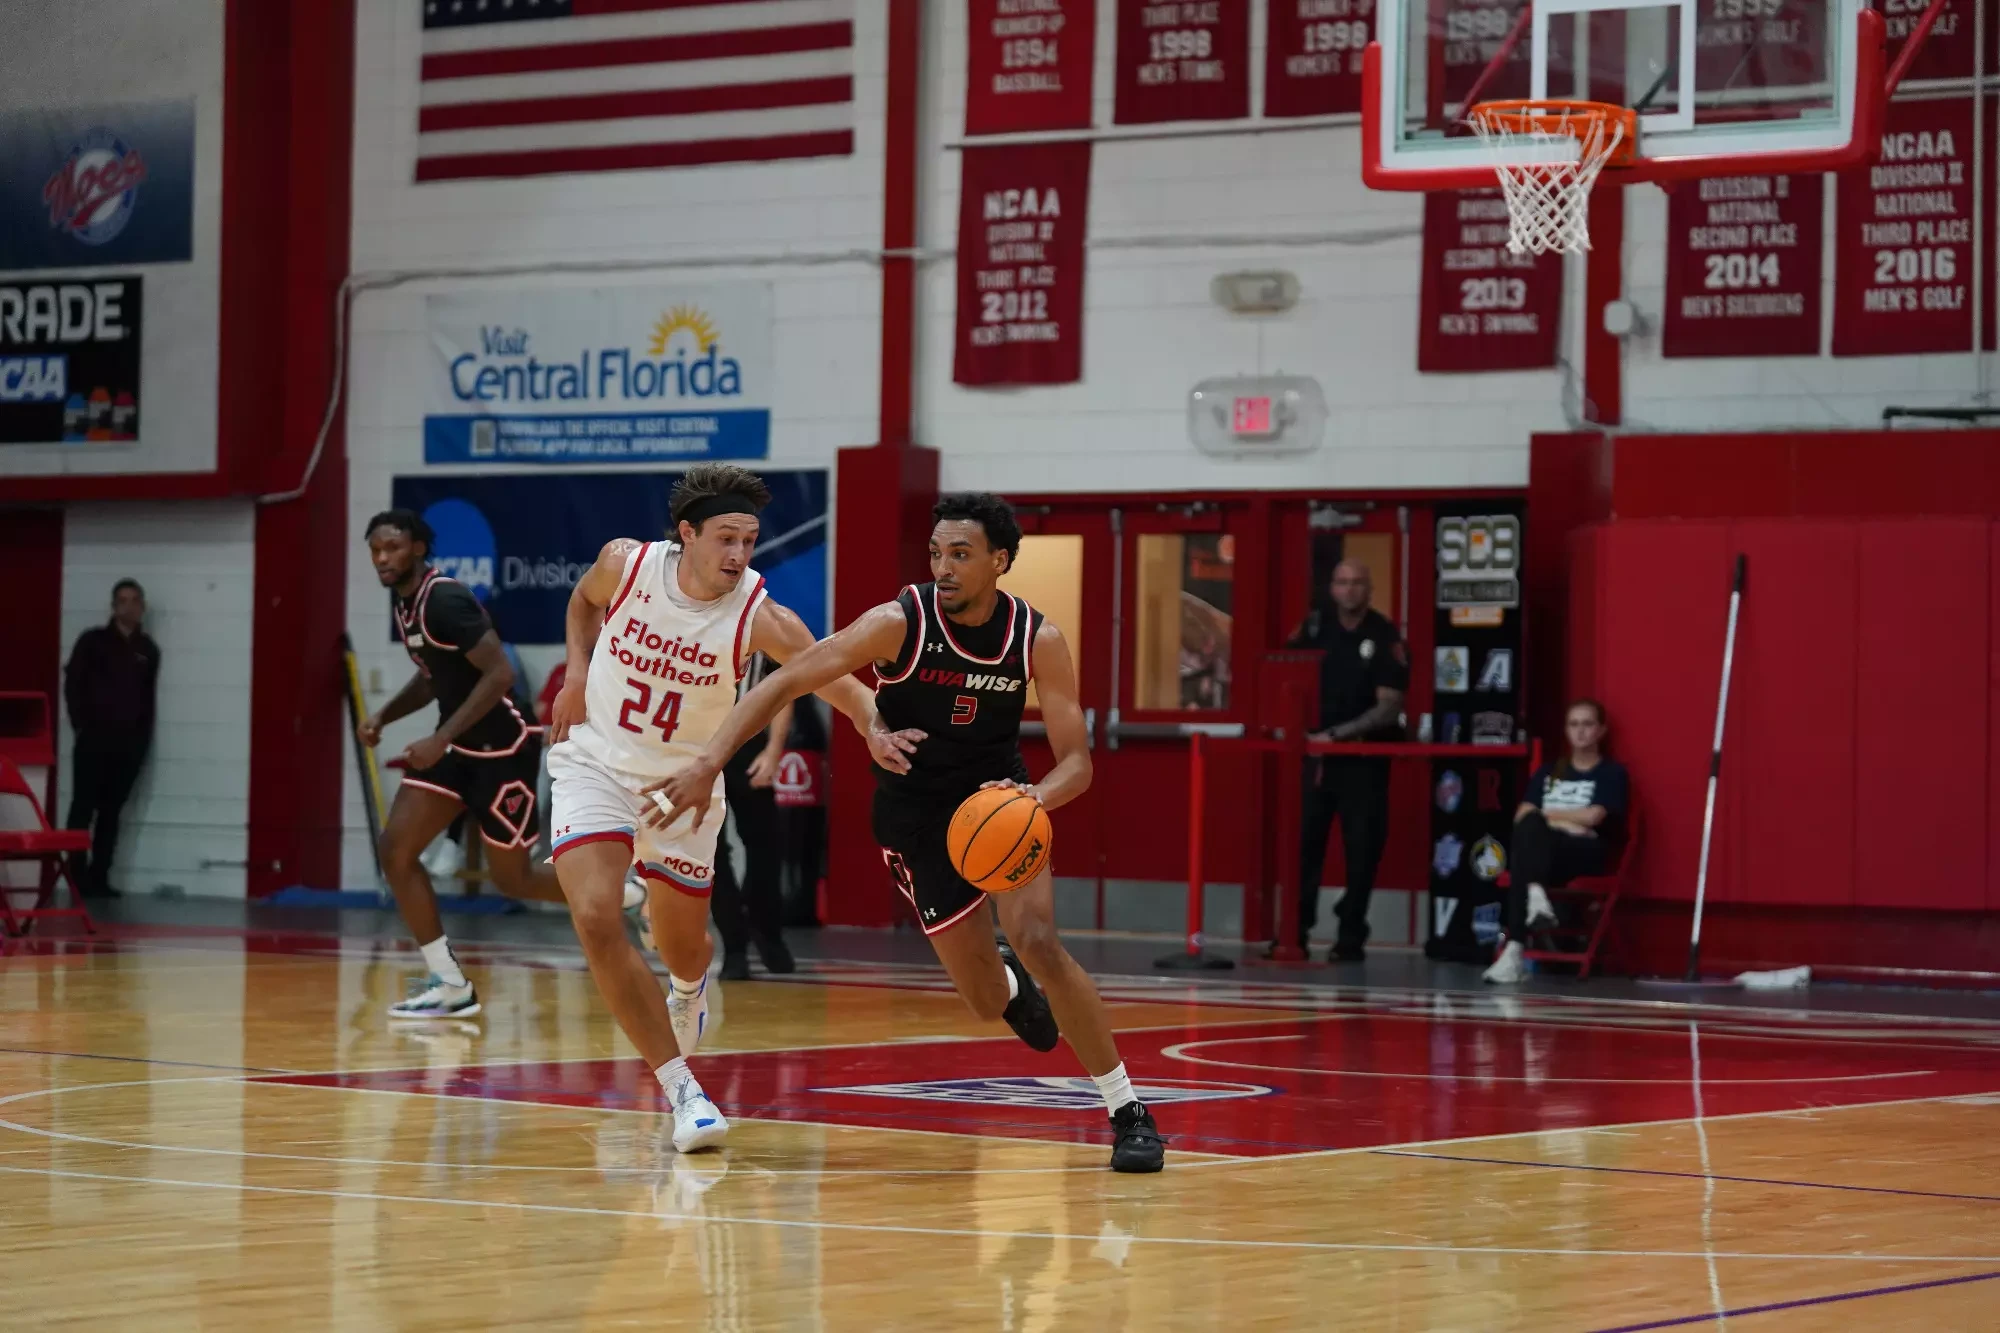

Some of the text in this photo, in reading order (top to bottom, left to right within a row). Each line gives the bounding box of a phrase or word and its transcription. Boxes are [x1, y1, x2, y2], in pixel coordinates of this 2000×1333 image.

[1002, 38, 1059, 68] 1994
[992, 72, 1063, 94] BASEBALL
[1881, 129, 1957, 162] NCAA
[1699, 176, 1771, 201] DIVISION
[1871, 161, 1966, 190] DIVISION II
[983, 187, 1061, 220] NCAA
[1708, 200, 1780, 223] NATIONAL
[1875, 191, 1959, 217] NATIONAL
[1689, 222, 1798, 250] SECOND PLACE
[1861, 218, 1971, 248] THIRD PLACE
[1704, 252, 1780, 290] 2014
[1874, 247, 1957, 284] 2016
[981, 289, 1049, 322] 2012
[1460, 277, 1527, 310] 2013
[1681, 292, 1804, 318] MEN'S SWIMMING
[1863, 285, 1967, 312] MEN'S GOLF
[0, 283, 124, 343] RADE
[480, 324, 531, 356] Visit
[0, 357, 65, 400] CAA
[451, 344, 742, 401] Central Florida
[503, 556, 592, 589] Divisio
[623, 617, 719, 668] Florida
[609, 636, 719, 687] Southern
[919, 668, 1022, 692] UVAWISE
[618, 677, 683, 742] 24
[951, 695, 978, 725] 3
[664, 856, 710, 879] MOCS
[1005, 837, 1043, 882] NCAA
